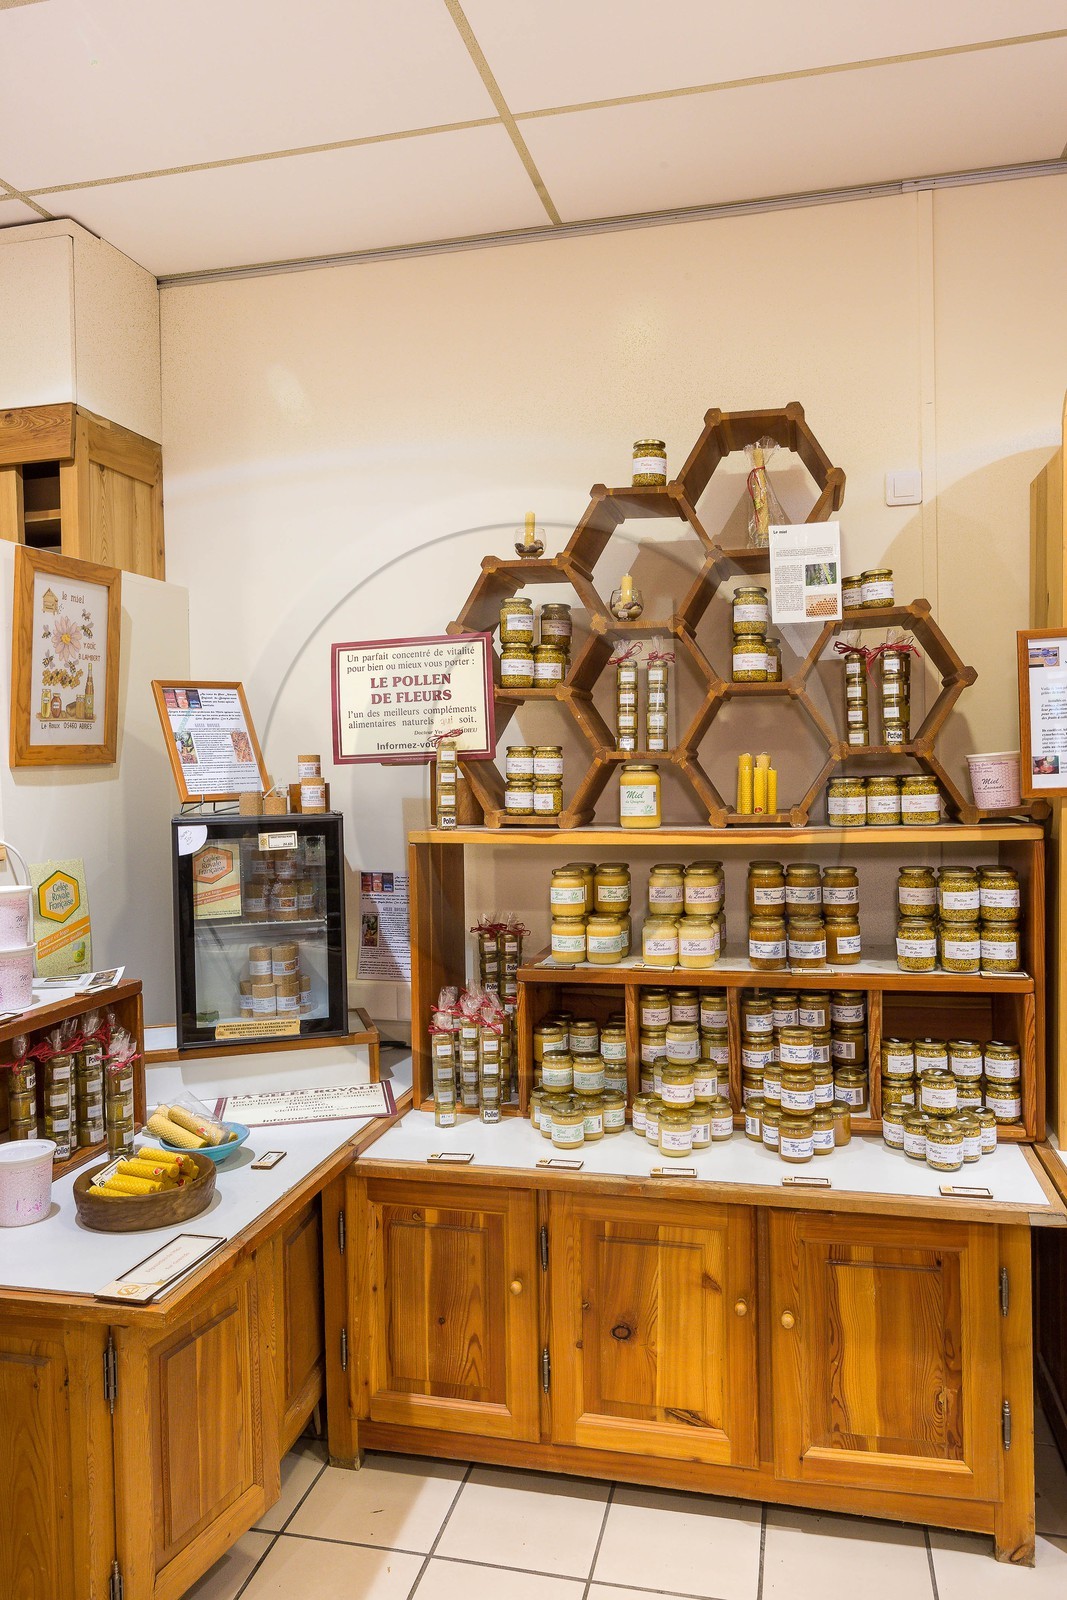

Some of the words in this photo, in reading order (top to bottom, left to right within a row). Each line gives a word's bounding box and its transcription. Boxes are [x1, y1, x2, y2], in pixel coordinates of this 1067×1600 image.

[62, 591, 67, 601] le
[71, 594, 84, 604] miel
[362, 653, 388, 663] parfait
[392, 650, 430, 660] concentré
[447, 647, 475, 656] vitalité
[347, 665, 364, 674] pour
[367, 663, 384, 671] bien
[445, 658, 469, 668] porter
[370, 677, 388, 688] LE
[392, 673, 451, 687] POLLEN
[371, 693, 392, 704] DE
[396, 689, 452, 703] FLEURS
[348, 710, 363, 718] l'un
[367, 709, 380, 717] des
[384, 707, 419, 716] meilleurs
[423, 705, 476, 715] compléments
[348, 720, 396, 729] alimentaires
[402, 717, 434, 726] naturels
[377, 741, 436, 750] Informez-vou
[626, 791, 644, 799] Miel
[53, 882, 68, 892] Gelée
[52, 890, 70, 901] Royale
[49, 899, 73, 910] Française
[314, 1085, 378, 1094] ROYALE
